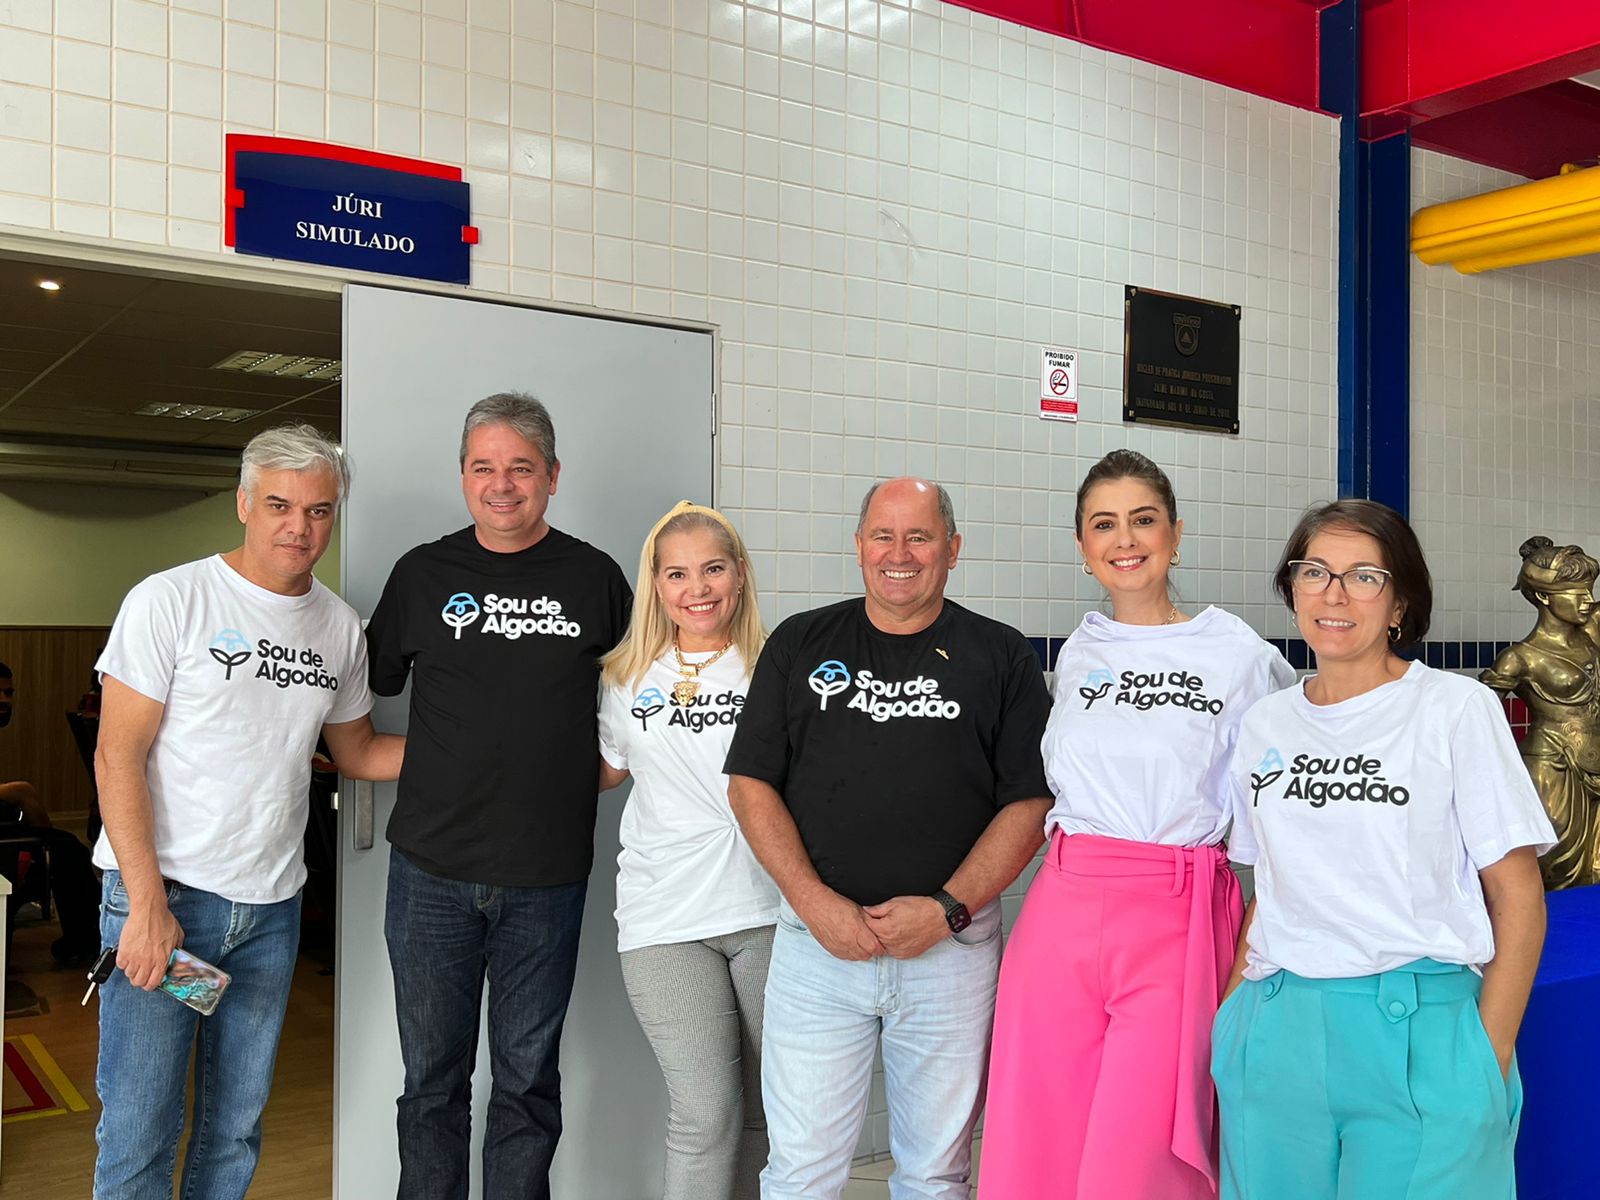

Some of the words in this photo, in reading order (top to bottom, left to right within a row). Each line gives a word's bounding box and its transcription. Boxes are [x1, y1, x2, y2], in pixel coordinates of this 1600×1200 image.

[332, 192, 383, 219] JÚRI
[296, 221, 415, 254] SIMULADO
[1045, 351, 1074, 361] PROIBIDO
[1049, 360, 1070, 368] FUMAR
[482, 593, 528, 614] Sou
[530, 596, 562, 615] de
[480, 614, 581, 640] Algodão
[257, 639, 296, 663] Sou
[300, 648, 323, 668] de
[255, 660, 338, 691] Algodão
[854, 670, 901, 698] Sou
[903, 675, 938, 696] de
[1120, 671, 1164, 690] Sou
[1168, 671, 1203, 691] de
[715, 690, 745, 706] de
[847, 690, 961, 723] Algodão
[1115, 690, 1224, 716] Algodão
[668, 708, 743, 734] Algod
[1290, 754, 1340, 775] Sou
[1343, 754, 1381, 775] de
[1283, 776, 1410, 808] Algodão
